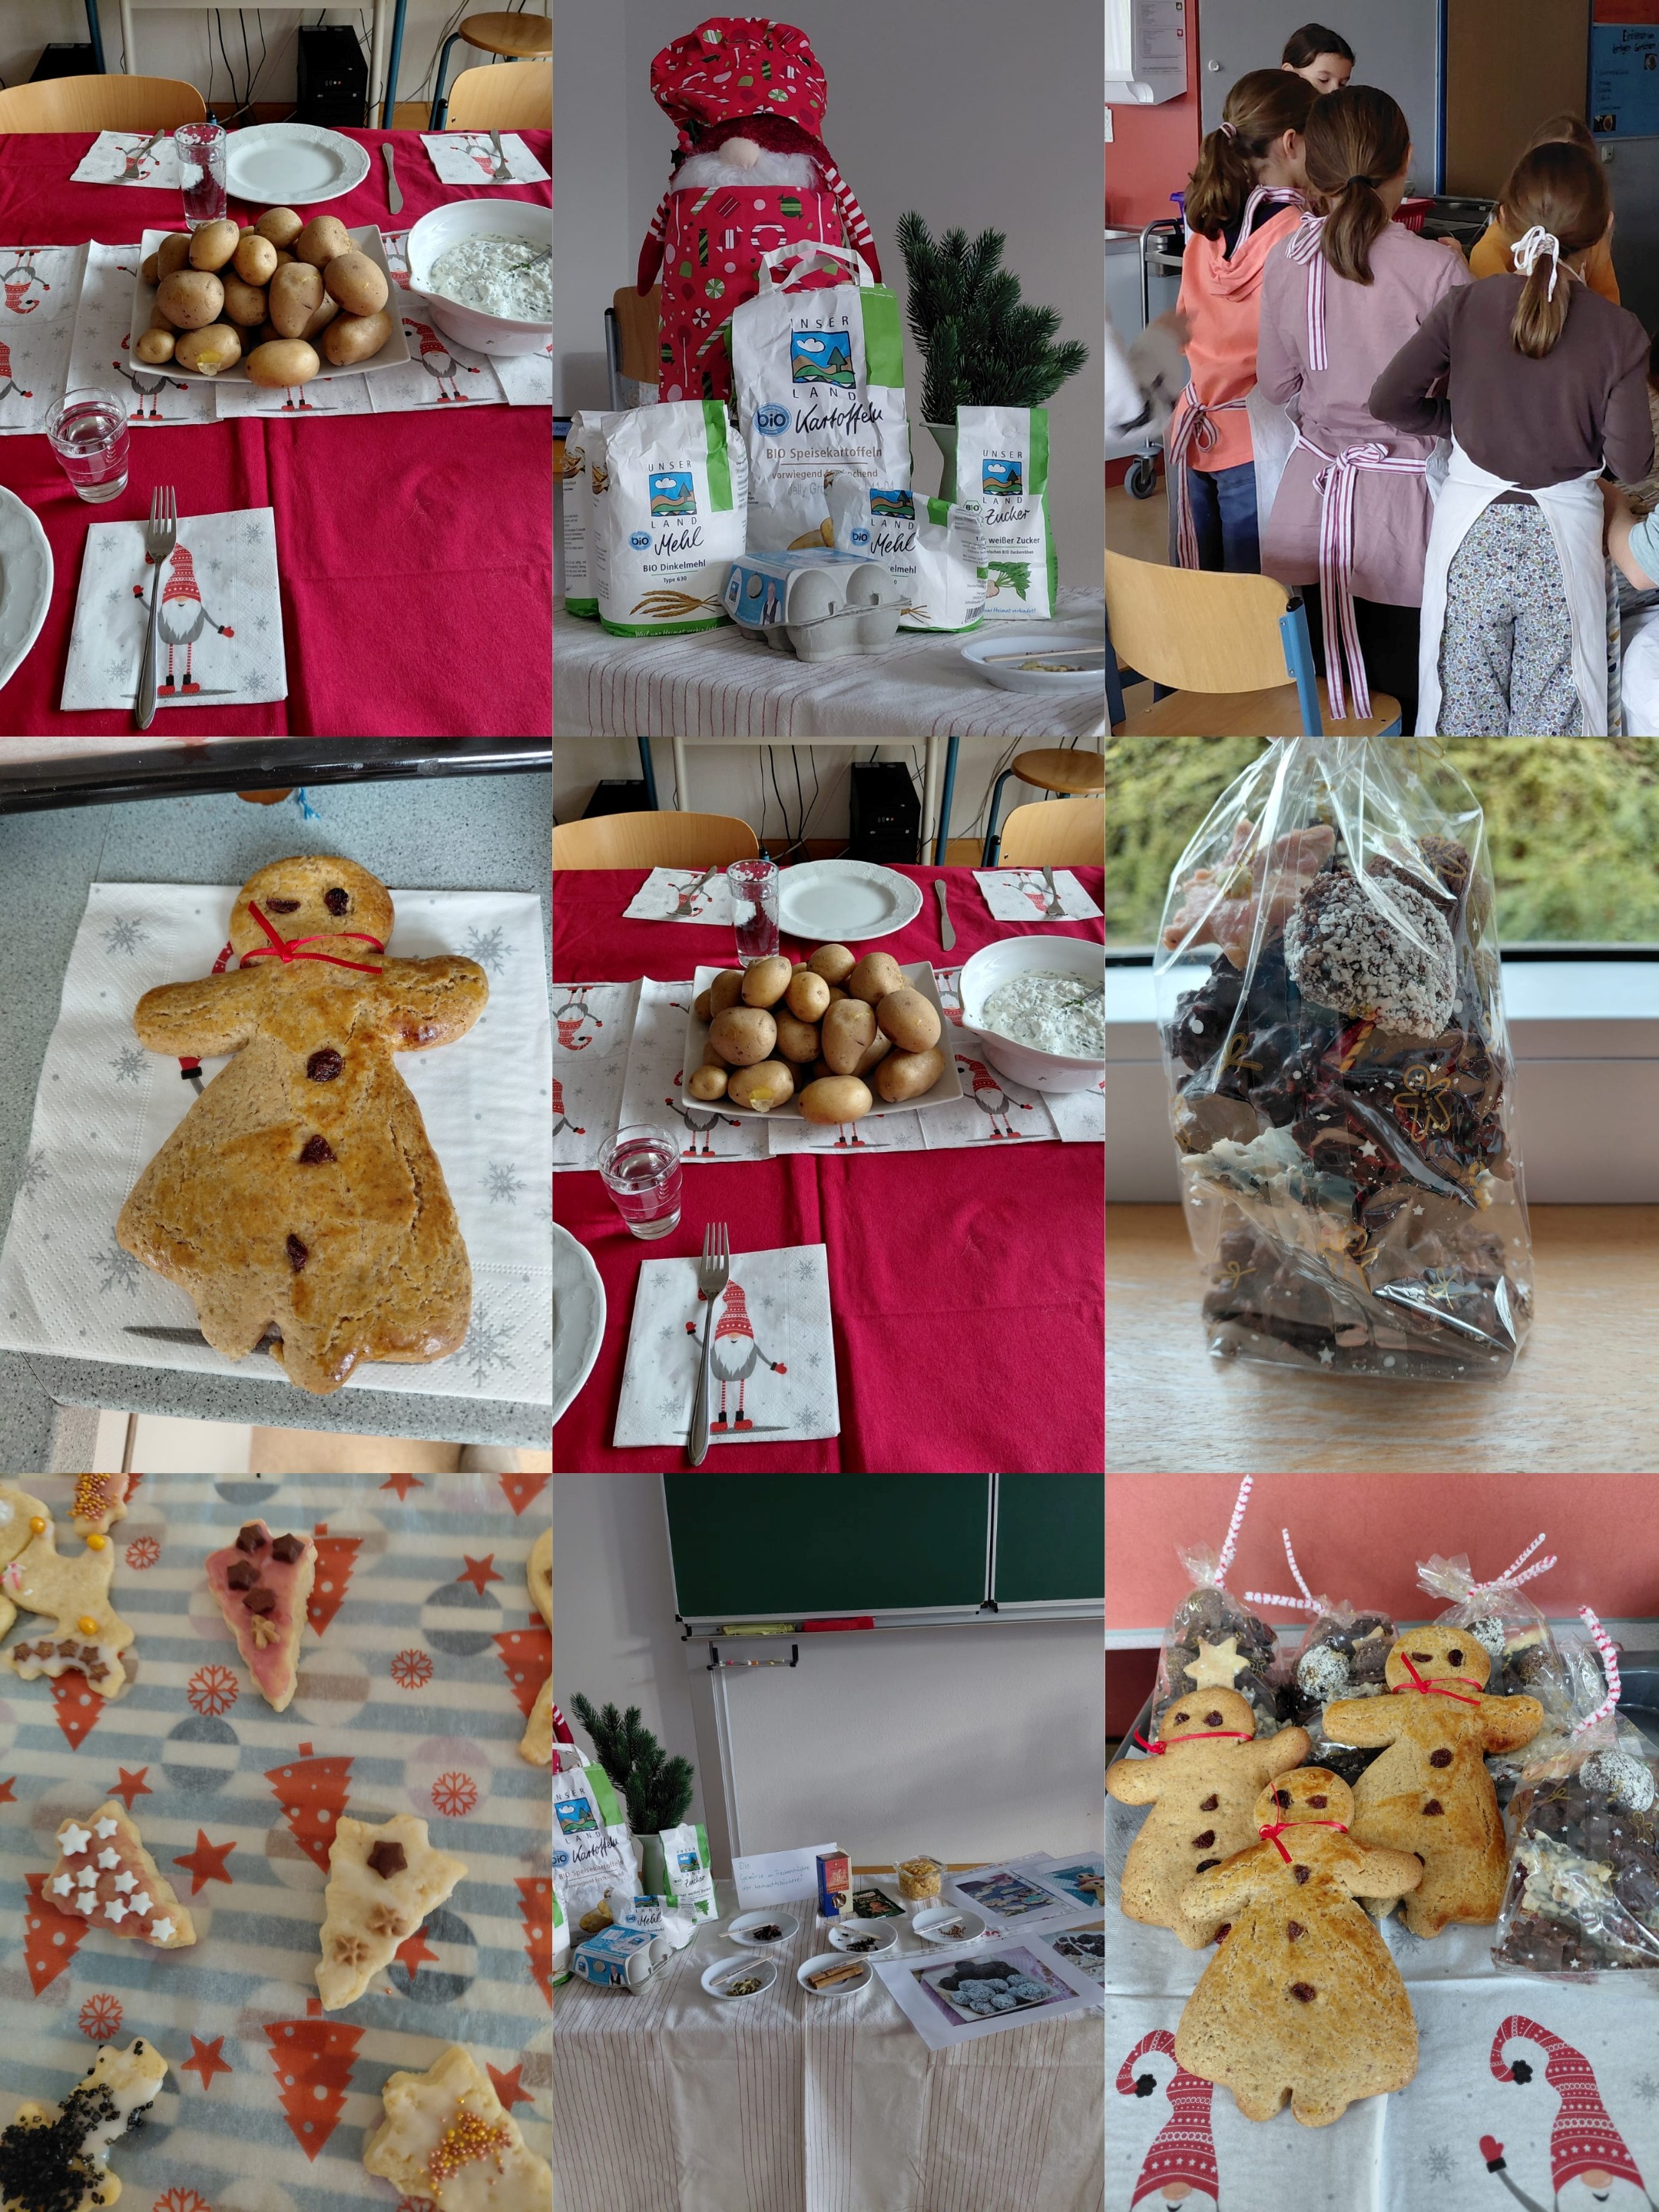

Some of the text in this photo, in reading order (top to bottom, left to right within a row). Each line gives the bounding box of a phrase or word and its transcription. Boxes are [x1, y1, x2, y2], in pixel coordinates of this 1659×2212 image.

[790, 316, 849, 329] NSER
[793, 386, 856, 401] LAND
[756, 409, 786, 428] bio
[795, 402, 884, 435] Kartoffeln
[767, 446, 882, 460] BIO Speisekartoffeln
[982, 449, 1023, 459] UNSER
[648, 460, 691, 472] UNSER
[772, 469, 823, 480] vorwiegend
[982, 496, 1023, 505] LAND
[985, 505, 1031, 525] Zucker
[651, 516, 697, 529] LAND
[871, 518, 914, 530] LAND
[631, 536, 649, 546] bio
[654, 525, 704, 557] Mehl
[852, 531, 868, 541] bio
[988, 536, 1040, 545] weißer Zucker
[870, 531, 916, 557] Mehl
[643, 559, 706, 573] BIO Dinkelmehl
[889, 564, 917, 575] elmehl
[555, 1787, 586, 1801] NSER
[565, 1831, 601, 1844] LAND
[572, 1836, 619, 1863] Kartoffeln
[571, 1859, 624, 1877] Speisekartoffeln
[738, 1861, 750, 1870] Die
[637, 1912, 663, 1927] Mehl
